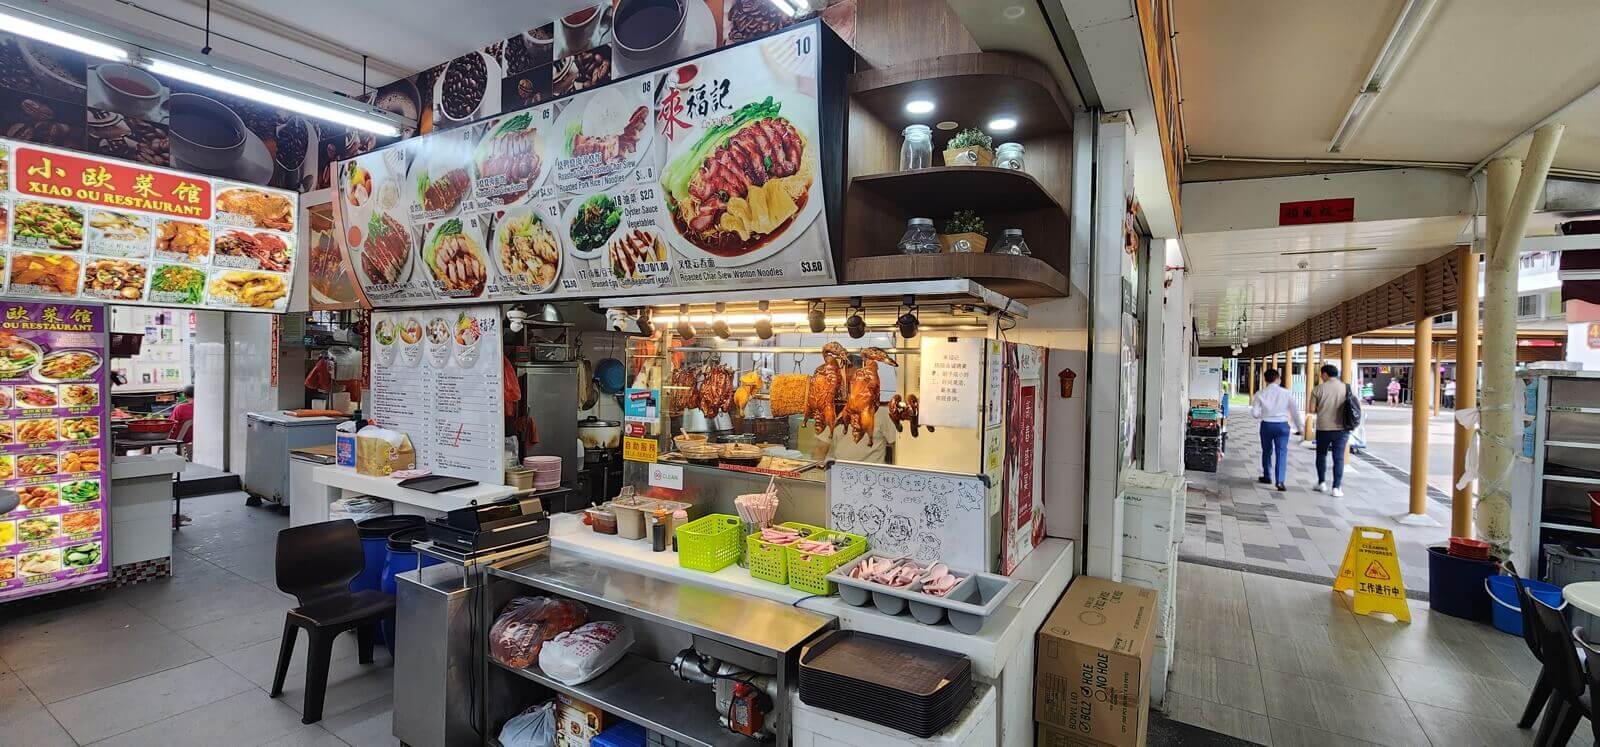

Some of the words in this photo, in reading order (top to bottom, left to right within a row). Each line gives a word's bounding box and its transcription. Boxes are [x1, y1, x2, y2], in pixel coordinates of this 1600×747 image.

[796, 36, 811, 56] 10
[642, 81, 651, 93] 08
[542, 109, 550, 119] 05
[27, 157, 203, 204] 小欧菜馆
[28, 181, 74, 198] XIAO
[76, 189, 101, 202] OU
[103, 193, 203, 217] RESTAURANT
[639, 188, 654, 201] $2/3
[549, 205, 558, 216] 12
[624, 207, 641, 217] Oyster
[641, 204, 658, 215] Sauce
[626, 218, 656, 229] Vegetables
[703, 270, 717, 281] Char
[757, 267, 785, 278] Noodles
[21, 322, 94, 332] RESTAURANT
[1361, 543, 1388, 551] CLEANING
[1363, 549, 1393, 557] PROGRESS
[1359, 582, 1400, 597] 工作进行中
[1097, 652, 1110, 676] HOLE
[1082, 663, 1094, 686] HOLE
[1096, 675, 1108, 690] NO
[1070, 691, 1079, 705] LID
[1069, 704, 1079, 730] BOWL
